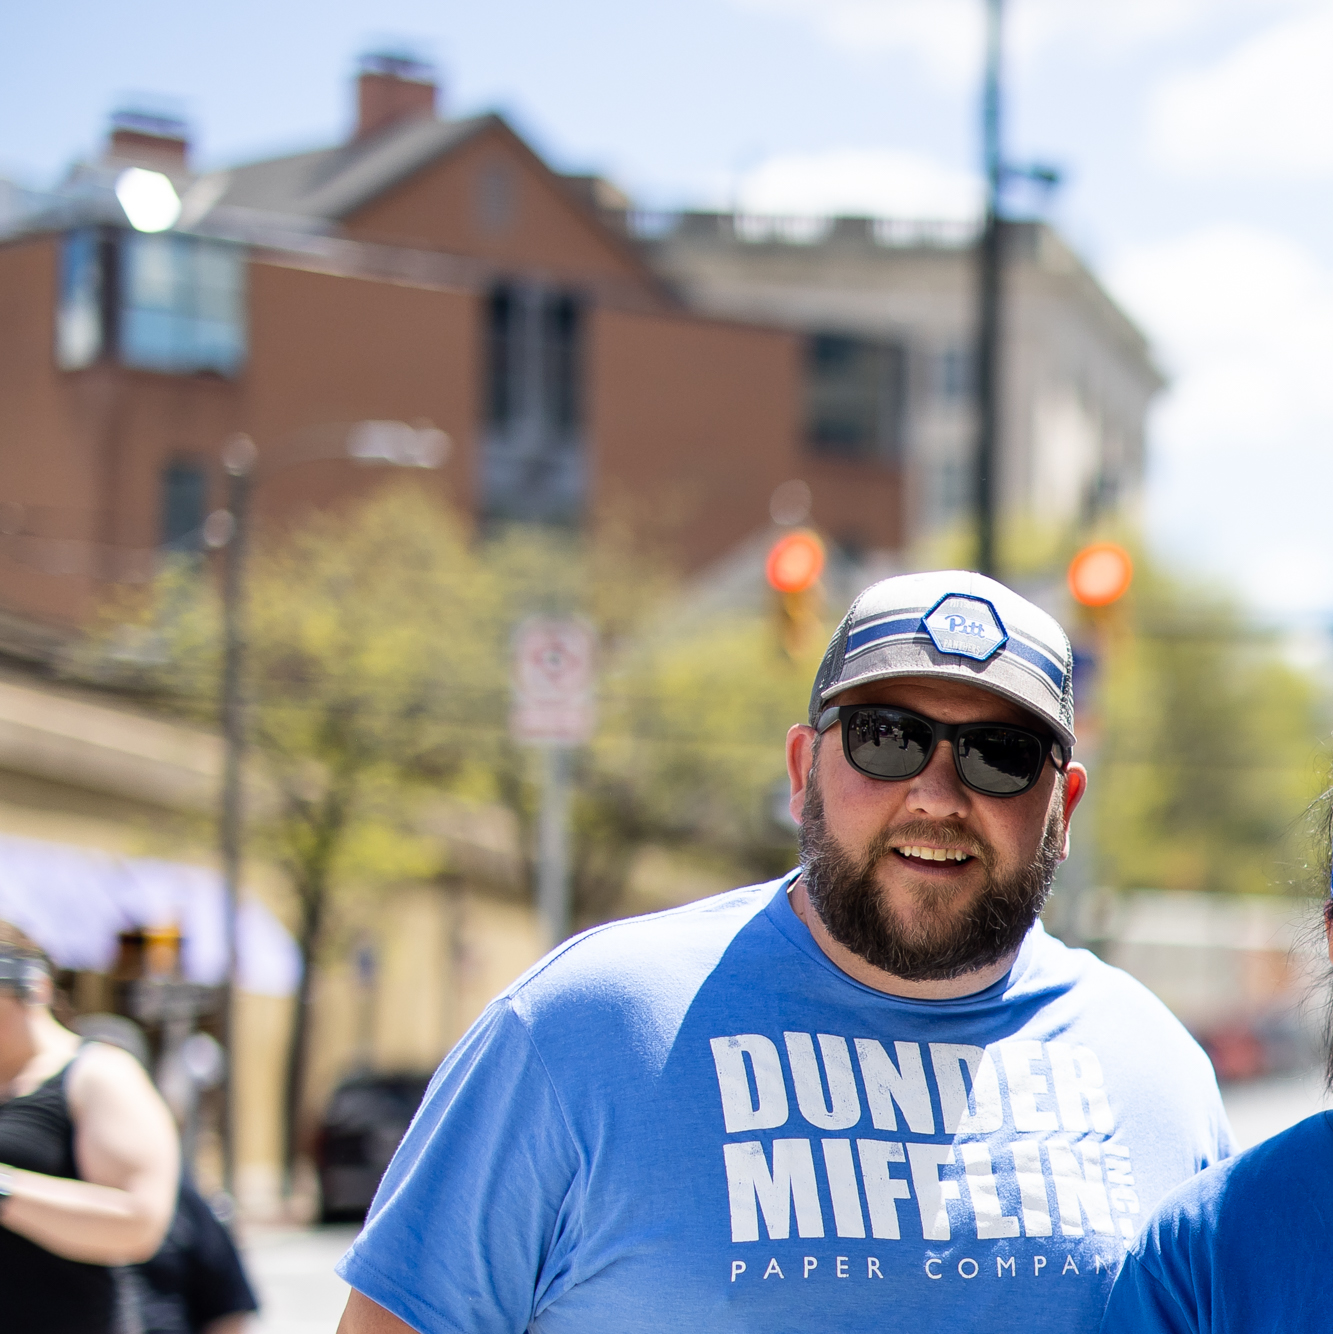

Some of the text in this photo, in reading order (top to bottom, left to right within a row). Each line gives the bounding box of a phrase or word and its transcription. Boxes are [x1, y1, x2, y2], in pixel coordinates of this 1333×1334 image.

[944, 614, 986, 639] Pitt
[943, 638, 981, 656] PANTHERS
[709, 1031, 1116, 1135] DUNDER
[730, 1253, 1113, 1283] PAPER COMPAN
